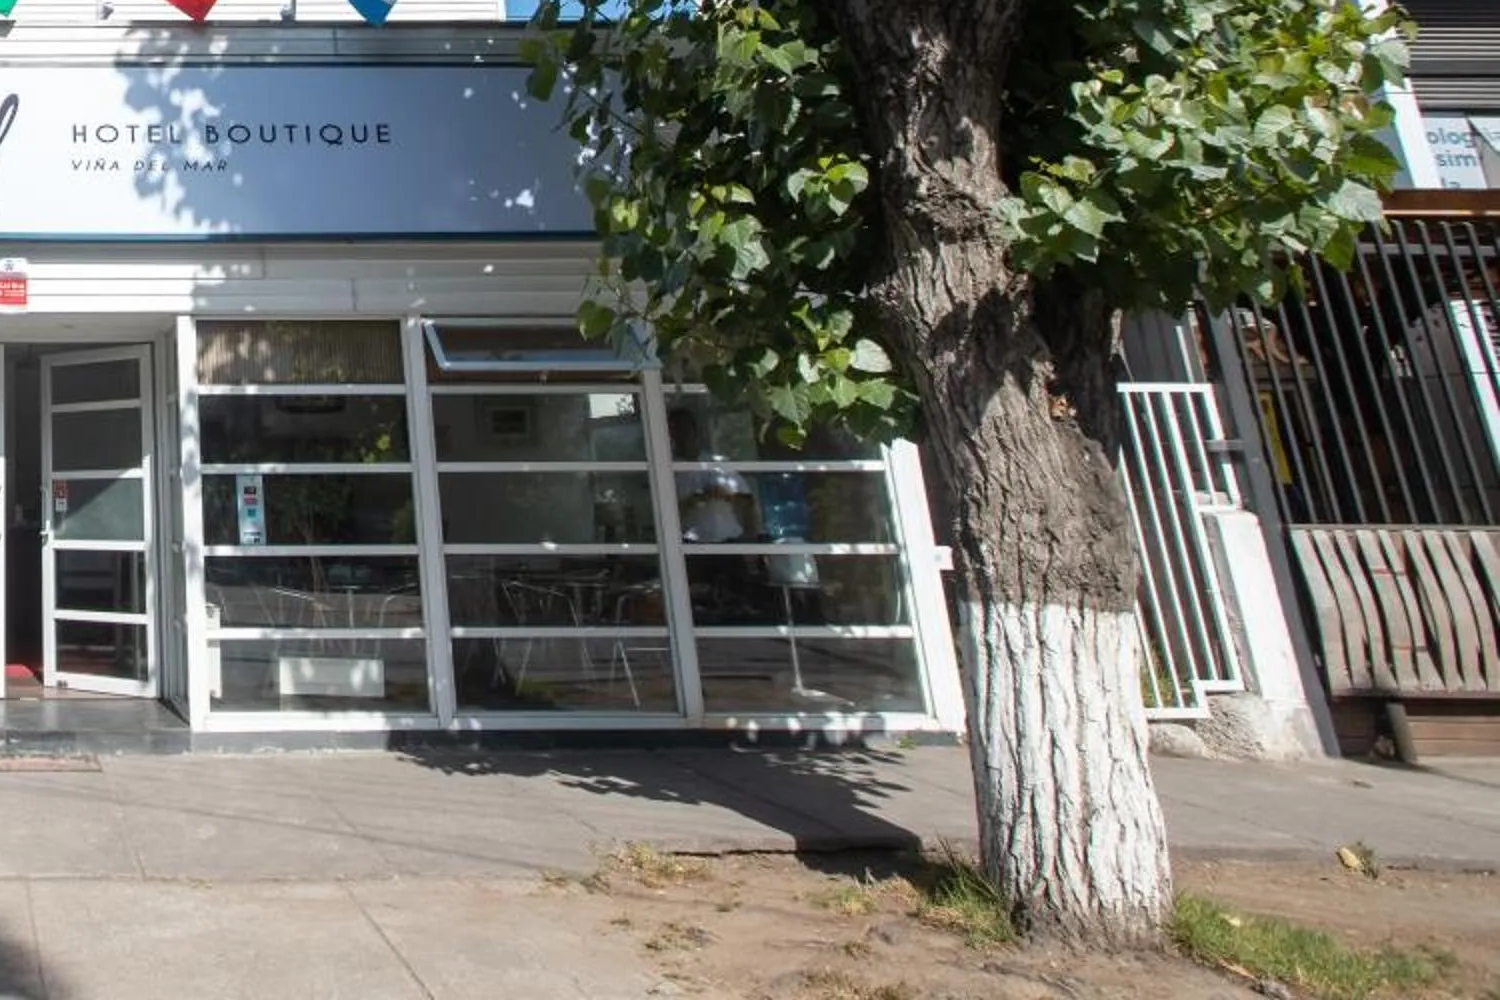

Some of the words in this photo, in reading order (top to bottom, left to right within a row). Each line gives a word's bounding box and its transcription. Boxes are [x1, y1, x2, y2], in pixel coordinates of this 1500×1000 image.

[72, 124, 182, 145] HOTEL
[205, 124, 392, 146] BOUTIQUE
[71, 156, 121, 171] VIÑA
[133, 159, 170, 171] DEL
[183, 159, 229, 171] MAR
